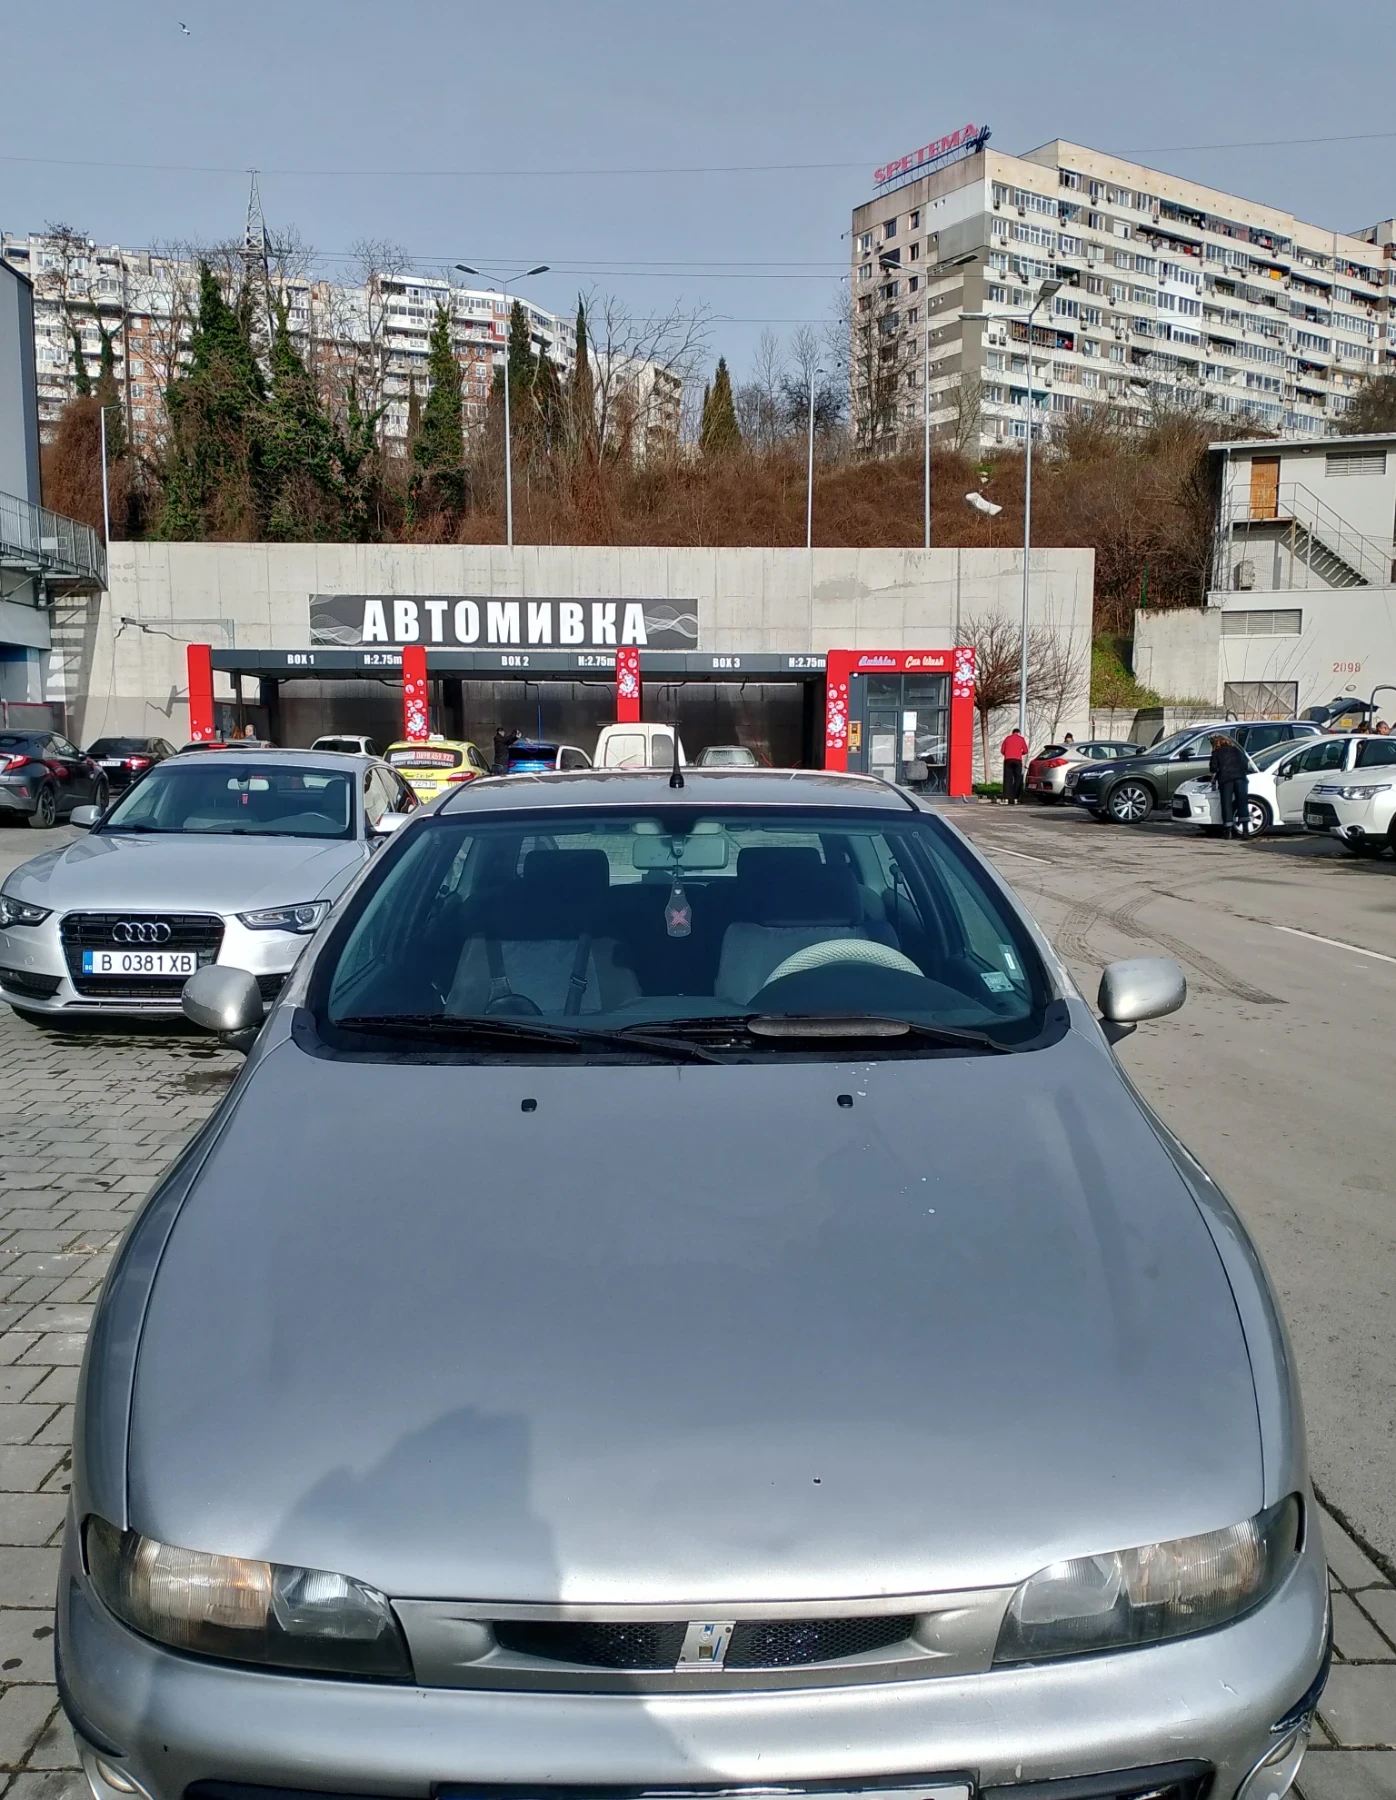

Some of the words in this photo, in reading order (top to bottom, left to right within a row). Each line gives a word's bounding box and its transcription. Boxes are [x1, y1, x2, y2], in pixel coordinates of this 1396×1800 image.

[873, 123, 979, 184] SPETEMA
[362, 599, 648, 645] АВТОМИВКА
[287, 654, 307, 665] BOX
[309, 655, 315, 665] 1
[364, 655, 403, 665] H:2.75m
[501, 656, 521, 666] BOX
[523, 656, 529, 666] 2
[578, 656, 616, 666] H:2.75m
[712, 658, 732, 668] BOX
[734, 658, 741, 668] 3
[788, 658, 826, 668] H:2.75m
[905, 656, 921, 668] Car
[922, 655, 945, 666] Wash
[1333, 662, 1361, 673] 2098
[102, 954, 112, 971] B
[122, 954, 163, 972] 0381
[169, 955, 192, 972] XB
